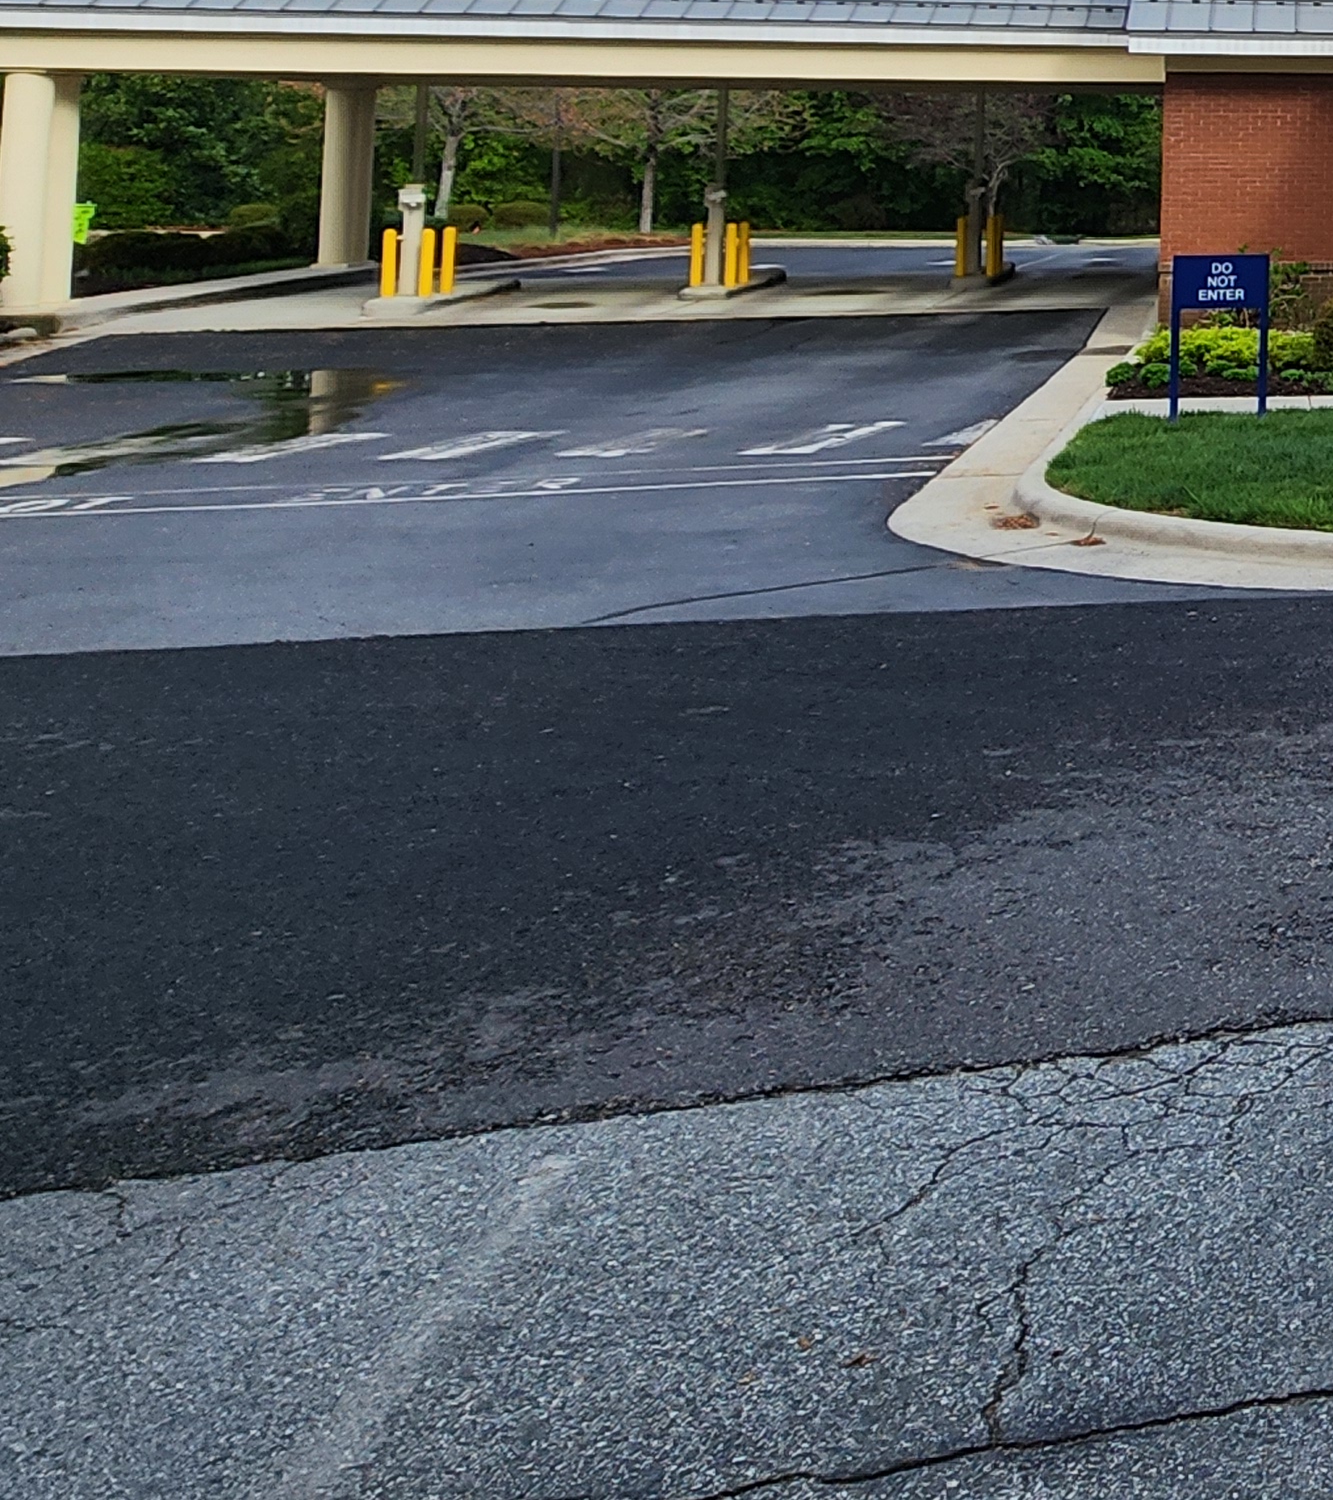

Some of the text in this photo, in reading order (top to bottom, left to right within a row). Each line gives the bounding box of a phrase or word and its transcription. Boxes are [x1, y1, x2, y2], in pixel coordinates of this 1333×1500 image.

[1211, 261, 1233, 275] DO
[1207, 275, 1237, 288] NOT
[1197, 288, 1245, 302] ENTER
